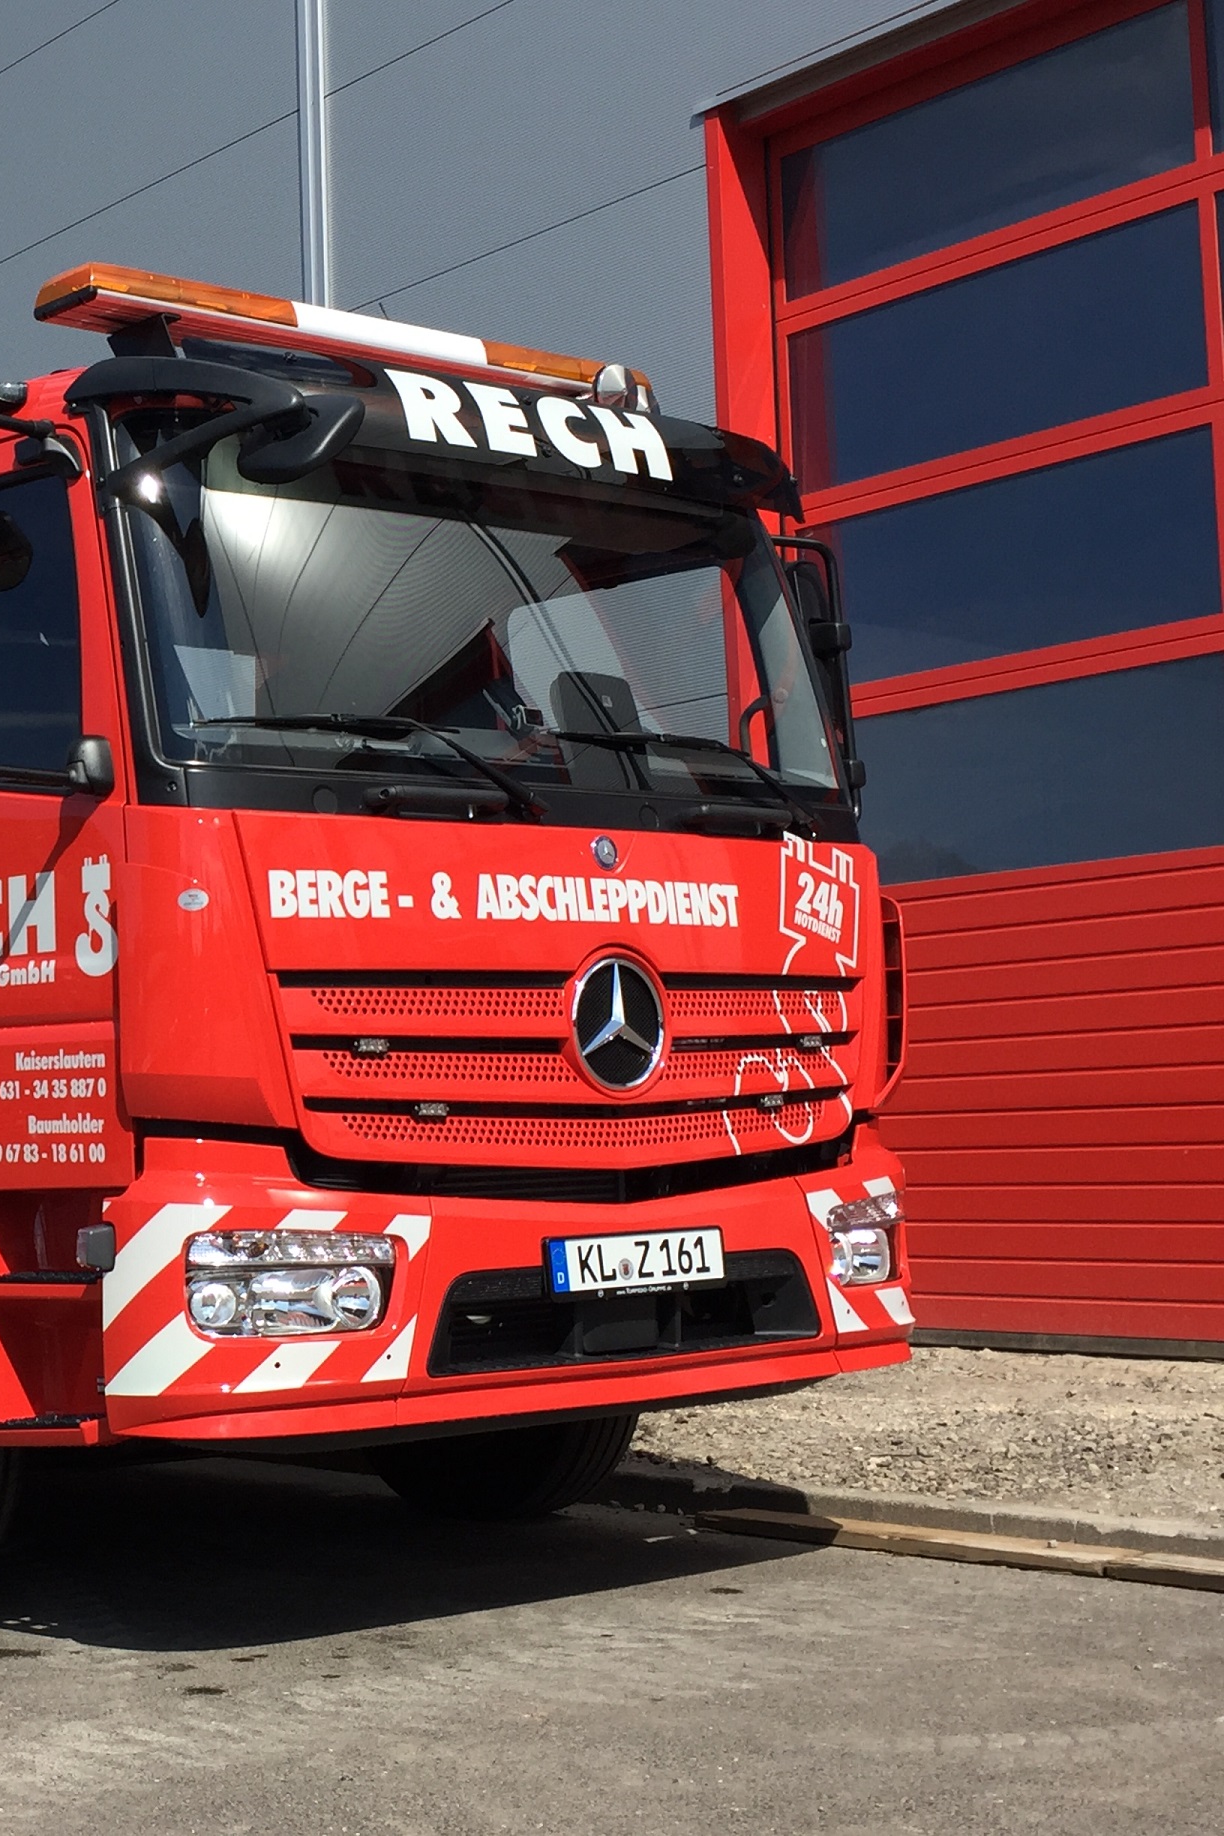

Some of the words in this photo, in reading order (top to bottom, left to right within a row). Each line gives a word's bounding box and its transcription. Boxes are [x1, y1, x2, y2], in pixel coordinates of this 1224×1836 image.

[383, 368, 674, 482] RECH
[431, 871, 462, 920] &
[477, 873, 739, 928] ABSCHLEPPDIENST
[794, 871, 844, 930] 24h
[793, 909, 842, 944] NOTDIENST
[14, 1048, 106, 1071] Kaiserslautern
[0, 1080, 21, 1100] 631
[32, 1079, 49, 1099] 34
[51, 1079, 67, 1099] 35
[70, 1077, 95, 1099] 887
[27, 1112, 105, 1134] Baumholder
[5, 1143, 21, 1163] 67
[23, 1143, 39, 1163] 83
[51, 1143, 67, 1163] 18
[69, 1143, 85, 1163] 61
[88, 1142, 106, 1163] 00
[557, 1271, 565, 1285] D
[577, 1243, 617, 1284] KL
